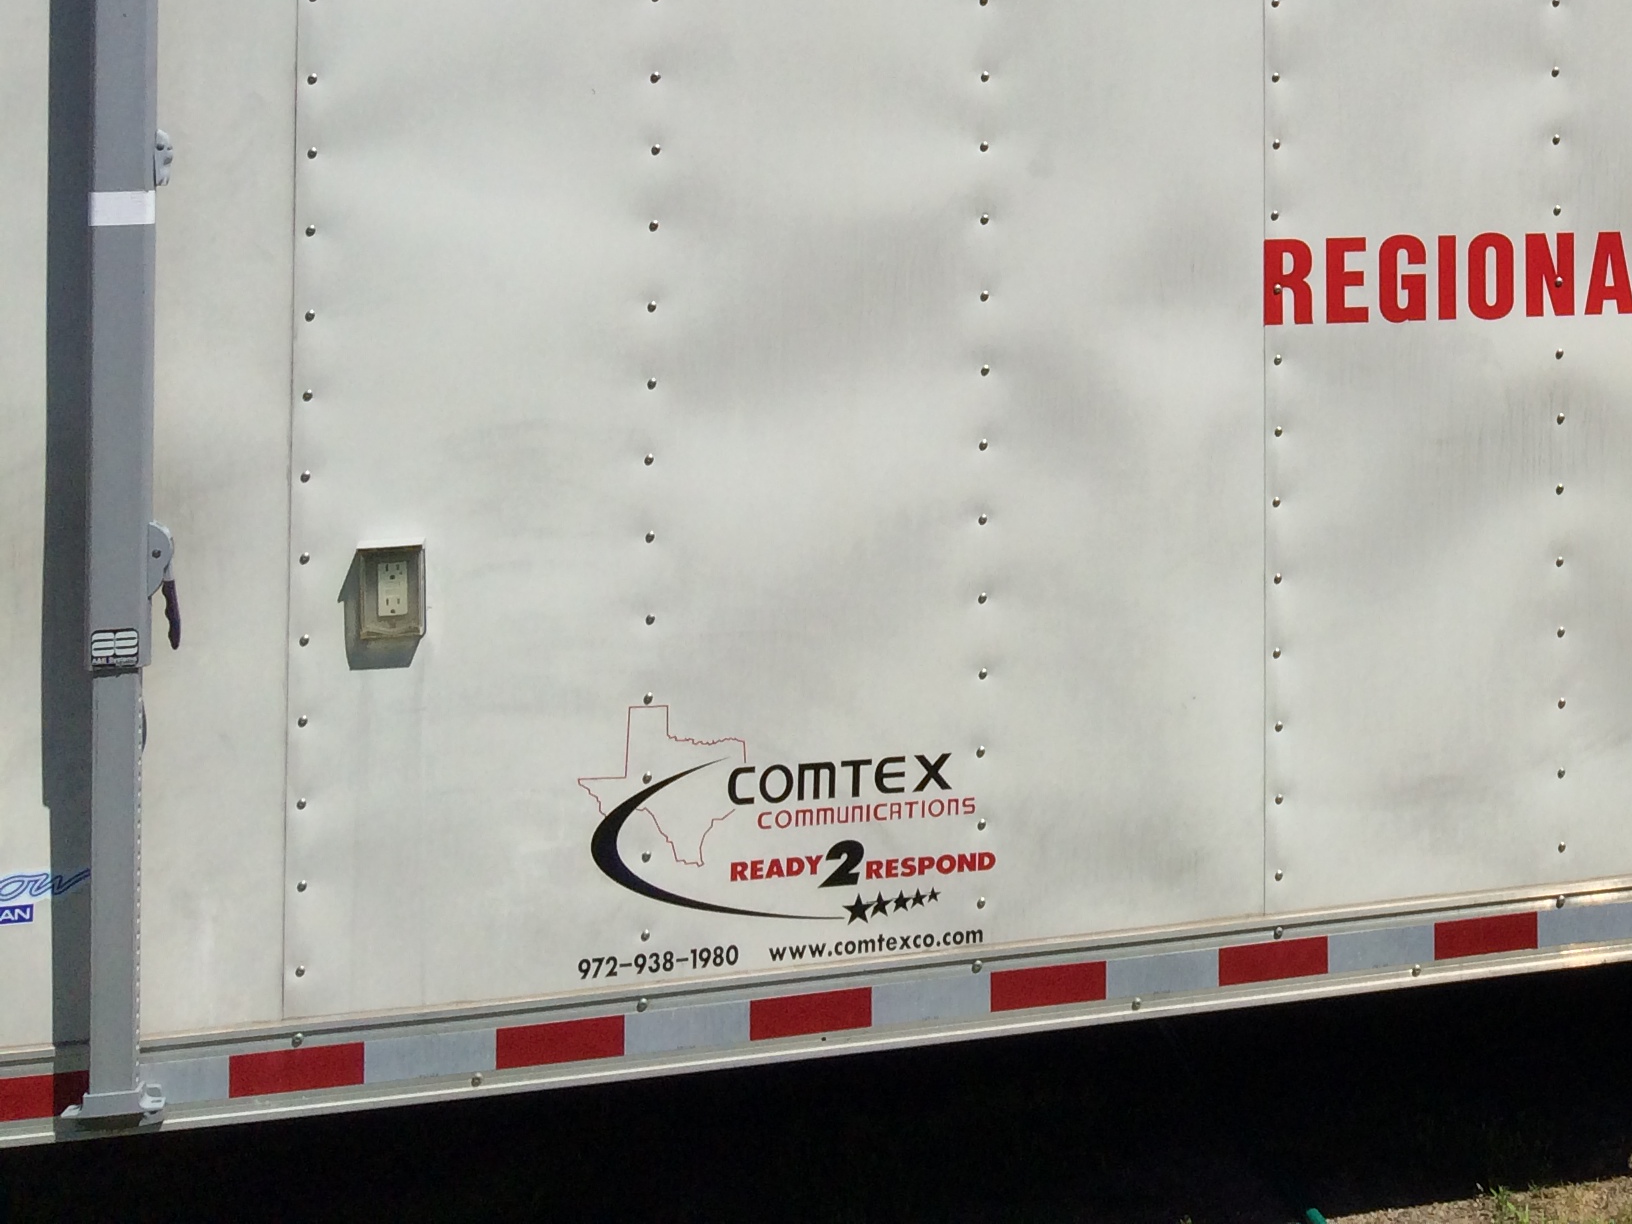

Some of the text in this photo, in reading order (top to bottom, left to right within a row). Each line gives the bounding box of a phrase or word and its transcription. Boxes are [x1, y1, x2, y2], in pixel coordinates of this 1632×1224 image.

[728, 753, 952, 805] COMTEX
[757, 797, 976, 829] COMMUNICATIONS
[578, 927, 985, 979] 972-938-1980 www.comtexco.com
